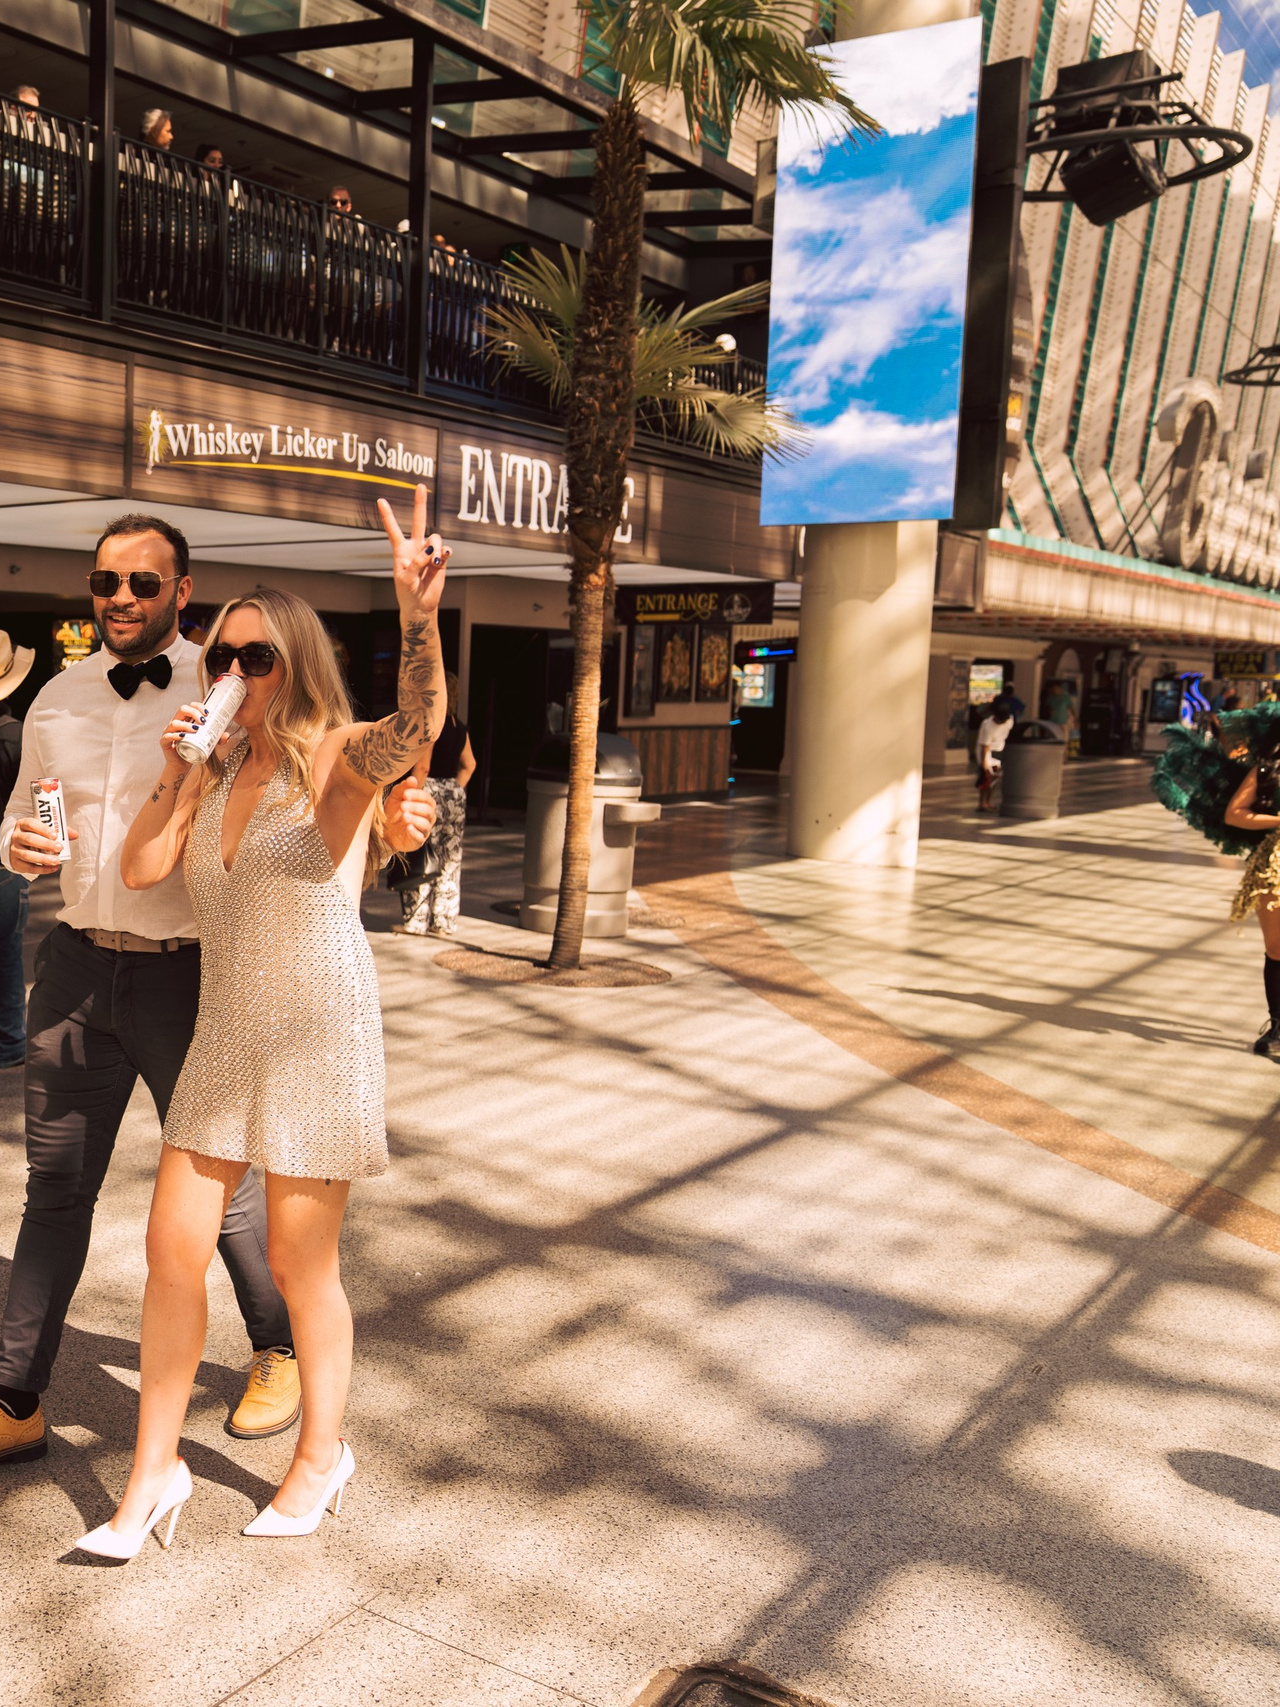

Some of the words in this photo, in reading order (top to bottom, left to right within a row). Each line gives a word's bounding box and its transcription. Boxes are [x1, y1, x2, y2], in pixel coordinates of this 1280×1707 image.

[164, 422, 265, 463] Whiskey
[270, 424, 338, 460] Licker
[342, 432, 371, 472] Up
[375, 438, 435, 478] Saloon
[457, 444, 635, 544] ENTRAE
[635, 592, 719, 612] ENTRANCE
